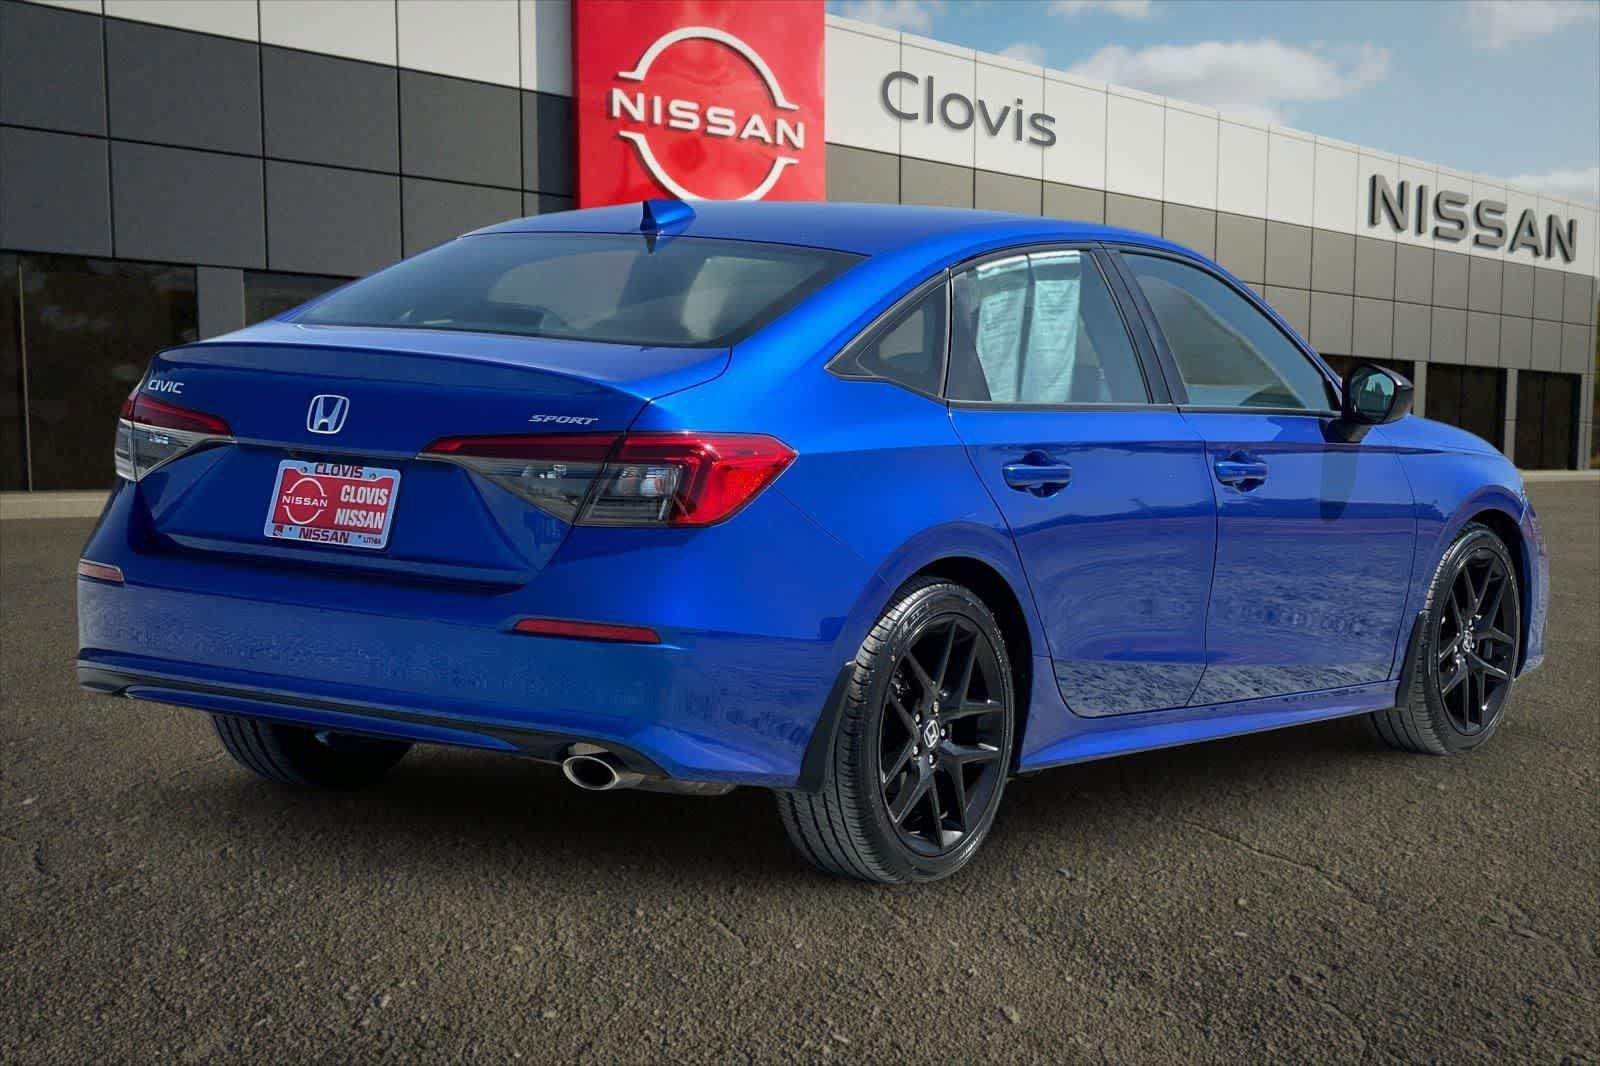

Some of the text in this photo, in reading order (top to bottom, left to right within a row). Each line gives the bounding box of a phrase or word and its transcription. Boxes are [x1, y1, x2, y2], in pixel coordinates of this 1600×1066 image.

[611, 87, 805, 149] NISSAN
[880, 70, 1057, 149] Clovis
[1367, 173, 1578, 263] NISSAN
[148, 379, 184, 394] CIVIC
[528, 414, 600, 425] SPORT
[314, 463, 363, 478] CLOVIS
[282, 495, 328, 507] NISSAN
[340, 485, 388, 505] CLOVIS
[334, 508, 385, 529] NISSAN
[298, 528, 349, 544] NISSAN
